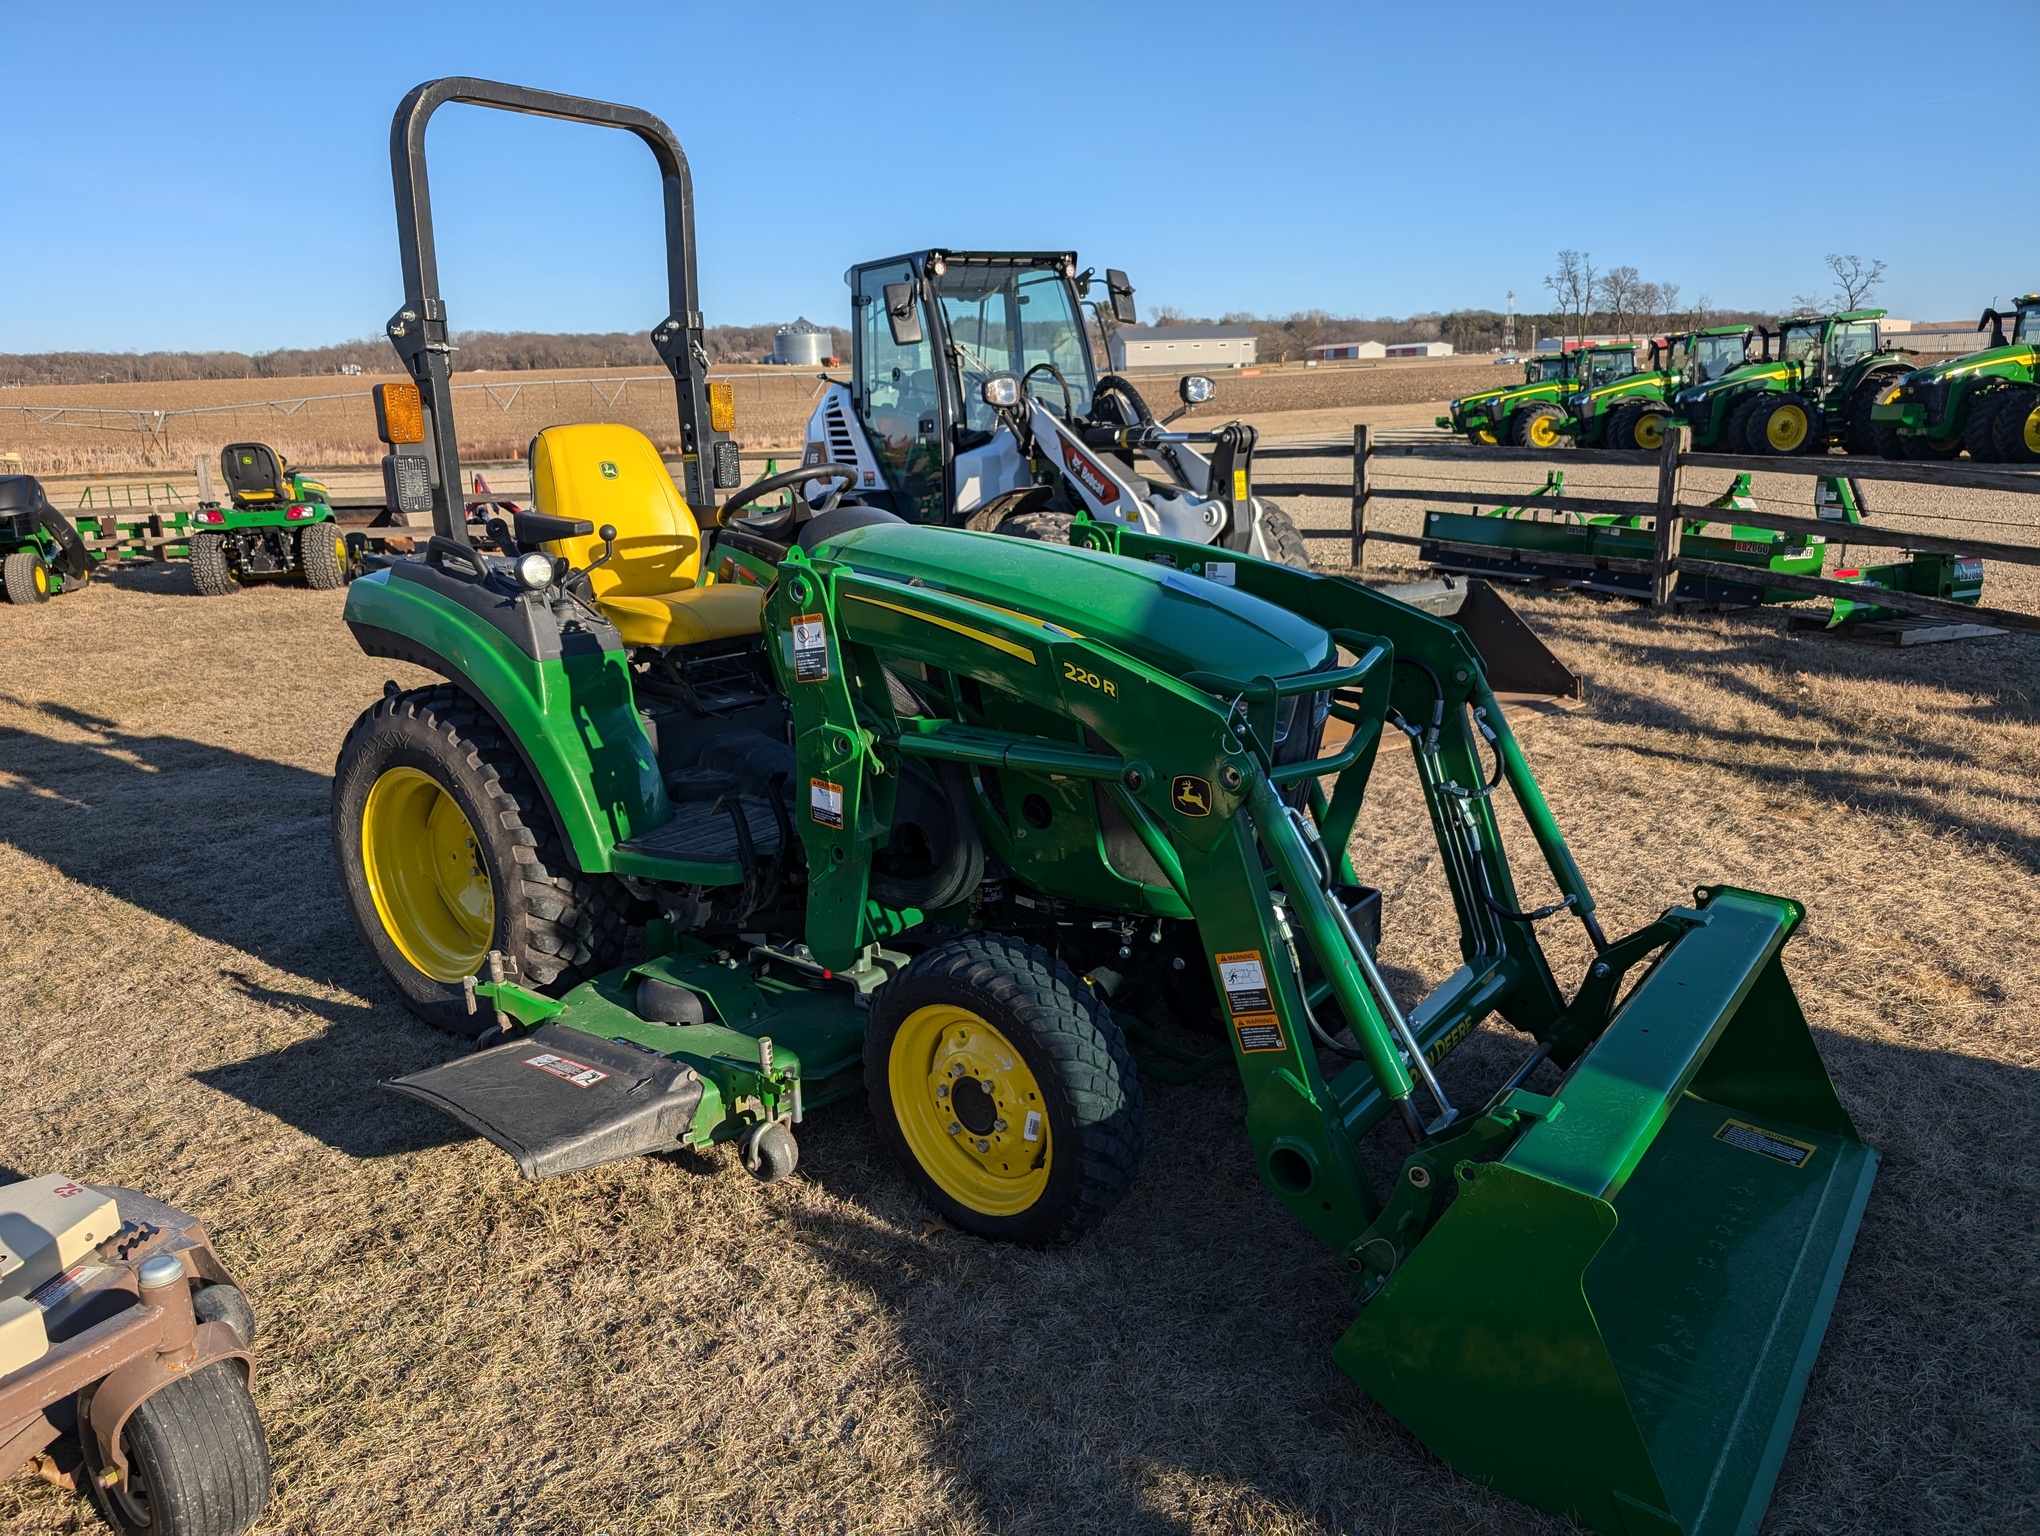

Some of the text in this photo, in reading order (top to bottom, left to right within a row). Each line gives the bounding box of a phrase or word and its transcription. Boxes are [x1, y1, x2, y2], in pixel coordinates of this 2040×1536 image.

[1081, 466, 1105, 497] Bobcat
[1735, 541, 1769, 554] BB2060
[337, 730, 413, 840] GALAXY
[1227, 953, 1255, 961] WARNING
[1433, 1015, 1473, 1062] DEERE
[1761, 1130, 1796, 1144] CAUTION
